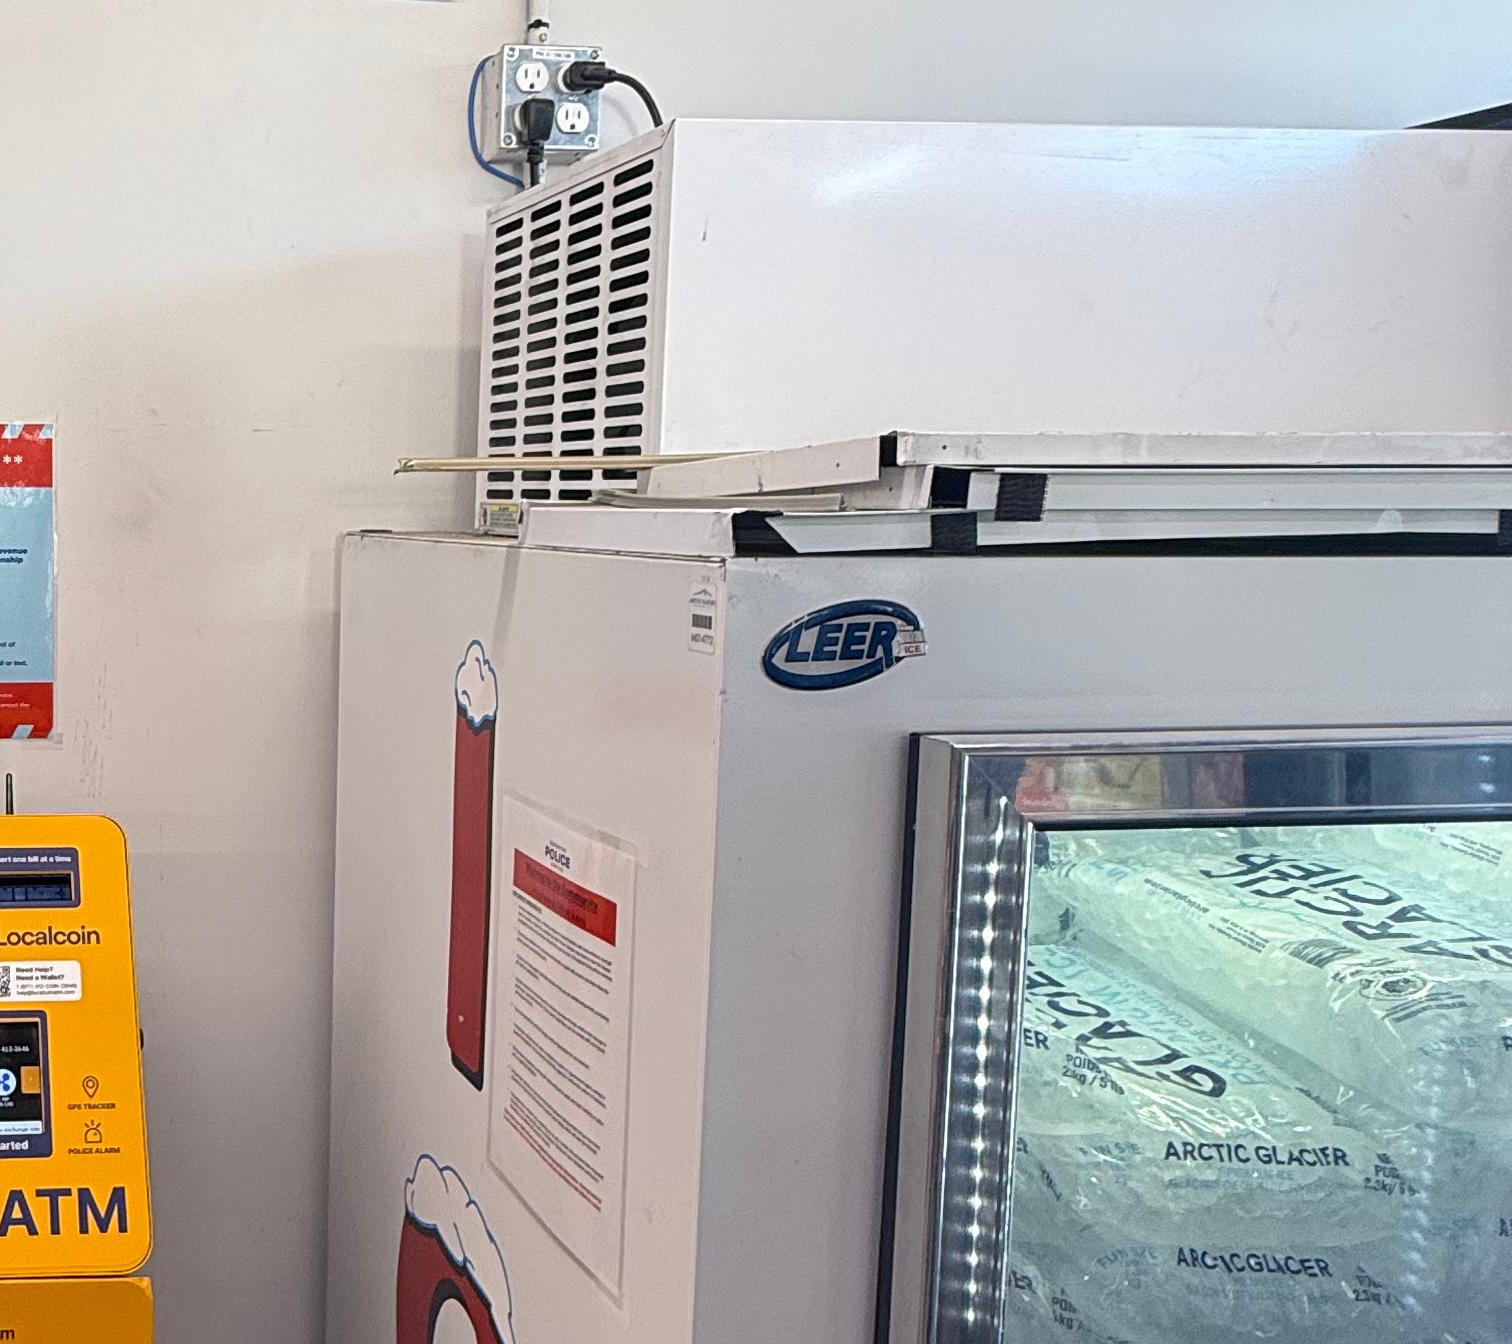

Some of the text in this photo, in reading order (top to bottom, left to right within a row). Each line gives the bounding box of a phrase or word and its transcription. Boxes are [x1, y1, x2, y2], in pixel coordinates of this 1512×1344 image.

[785, 621, 897, 669] LEER
[905, 645, 921, 653] ICE
[545, 845, 570, 869] POLICE
[1164, 1141, 1251, 1163] ARCTIC
